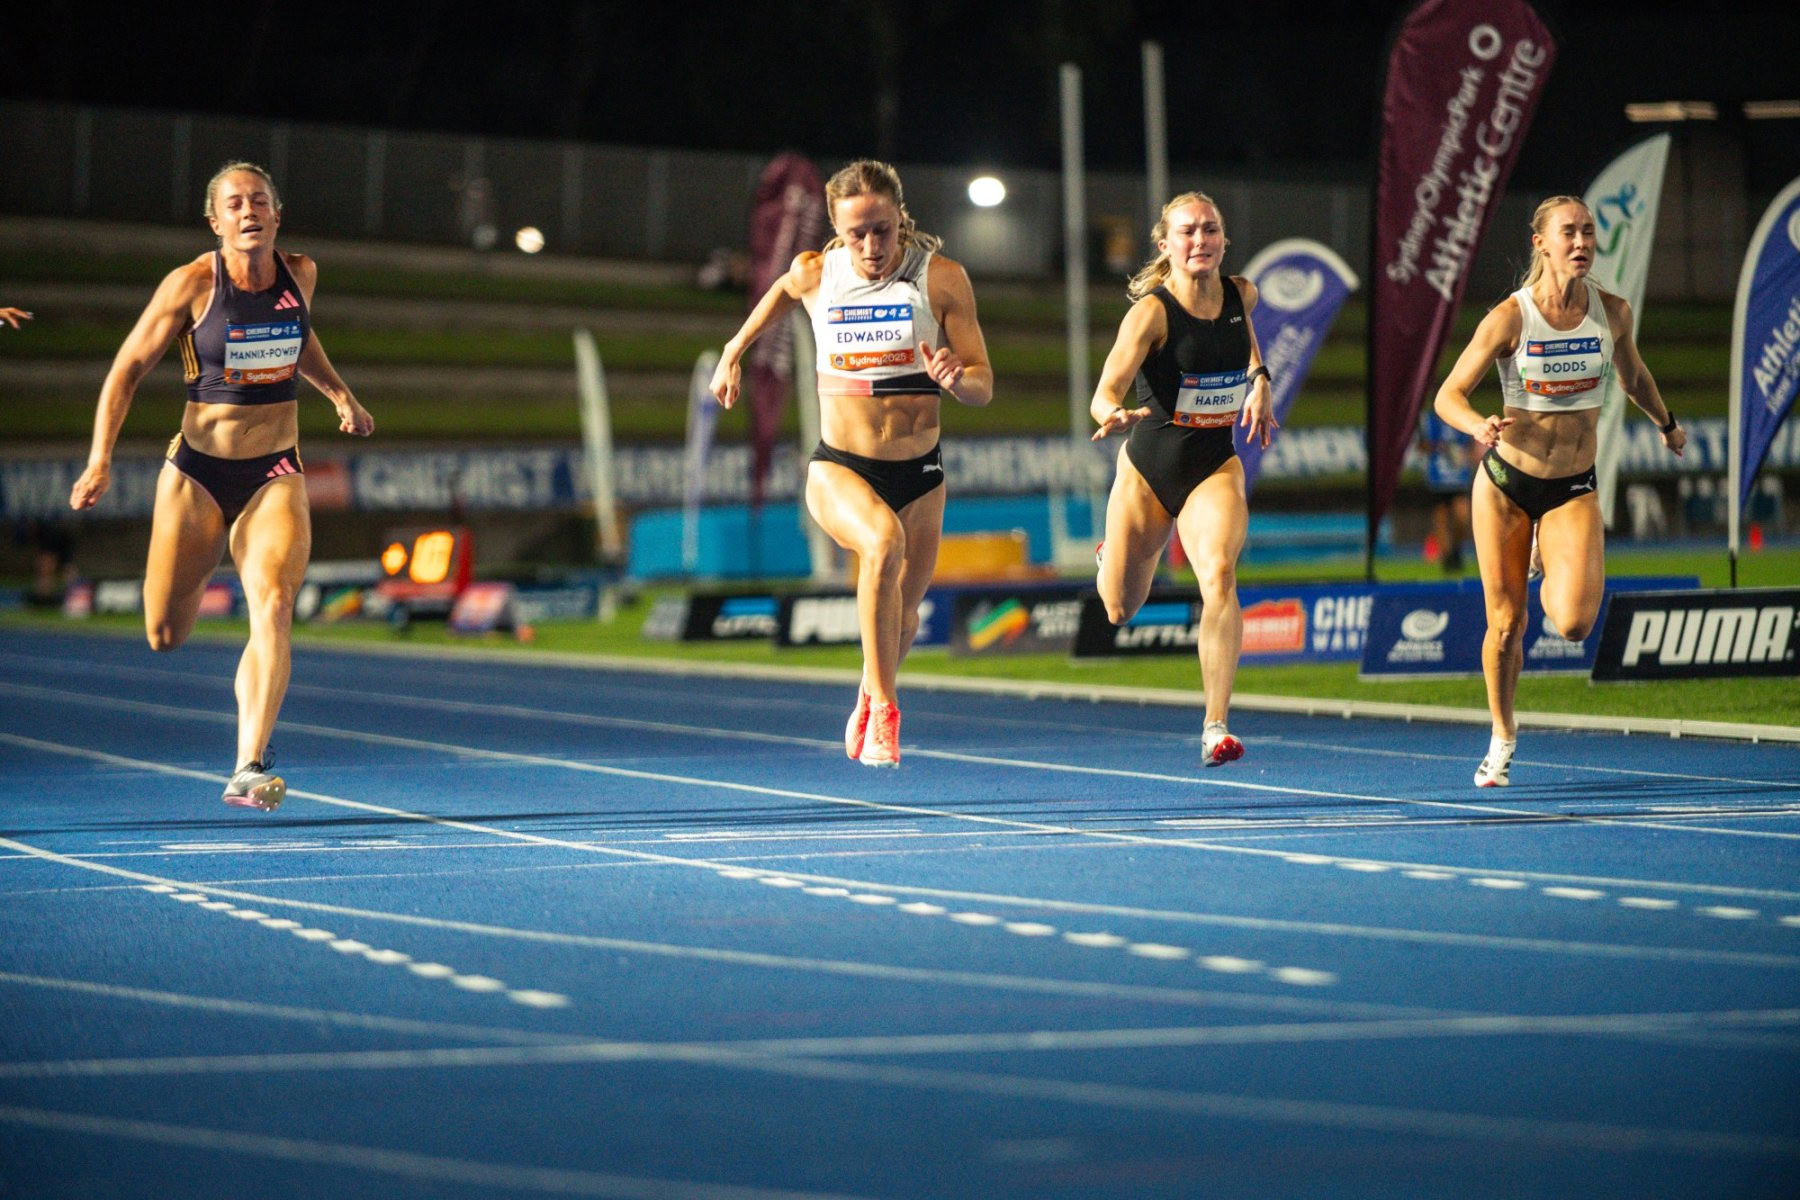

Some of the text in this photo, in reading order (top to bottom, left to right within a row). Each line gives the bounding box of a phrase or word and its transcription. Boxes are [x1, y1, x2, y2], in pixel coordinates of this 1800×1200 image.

[837, 329, 902, 344] EDWARDS
[230, 345, 298, 360] MANNIX-POWER
[1543, 360, 1587, 373] DODDS
[1195, 393, 1234, 407] HARRIS
[1195, 413, 1237, 426] Sydney202
[1114, 624, 1200, 647] LITTL
[1622, 606, 1793, 667] PUMA
